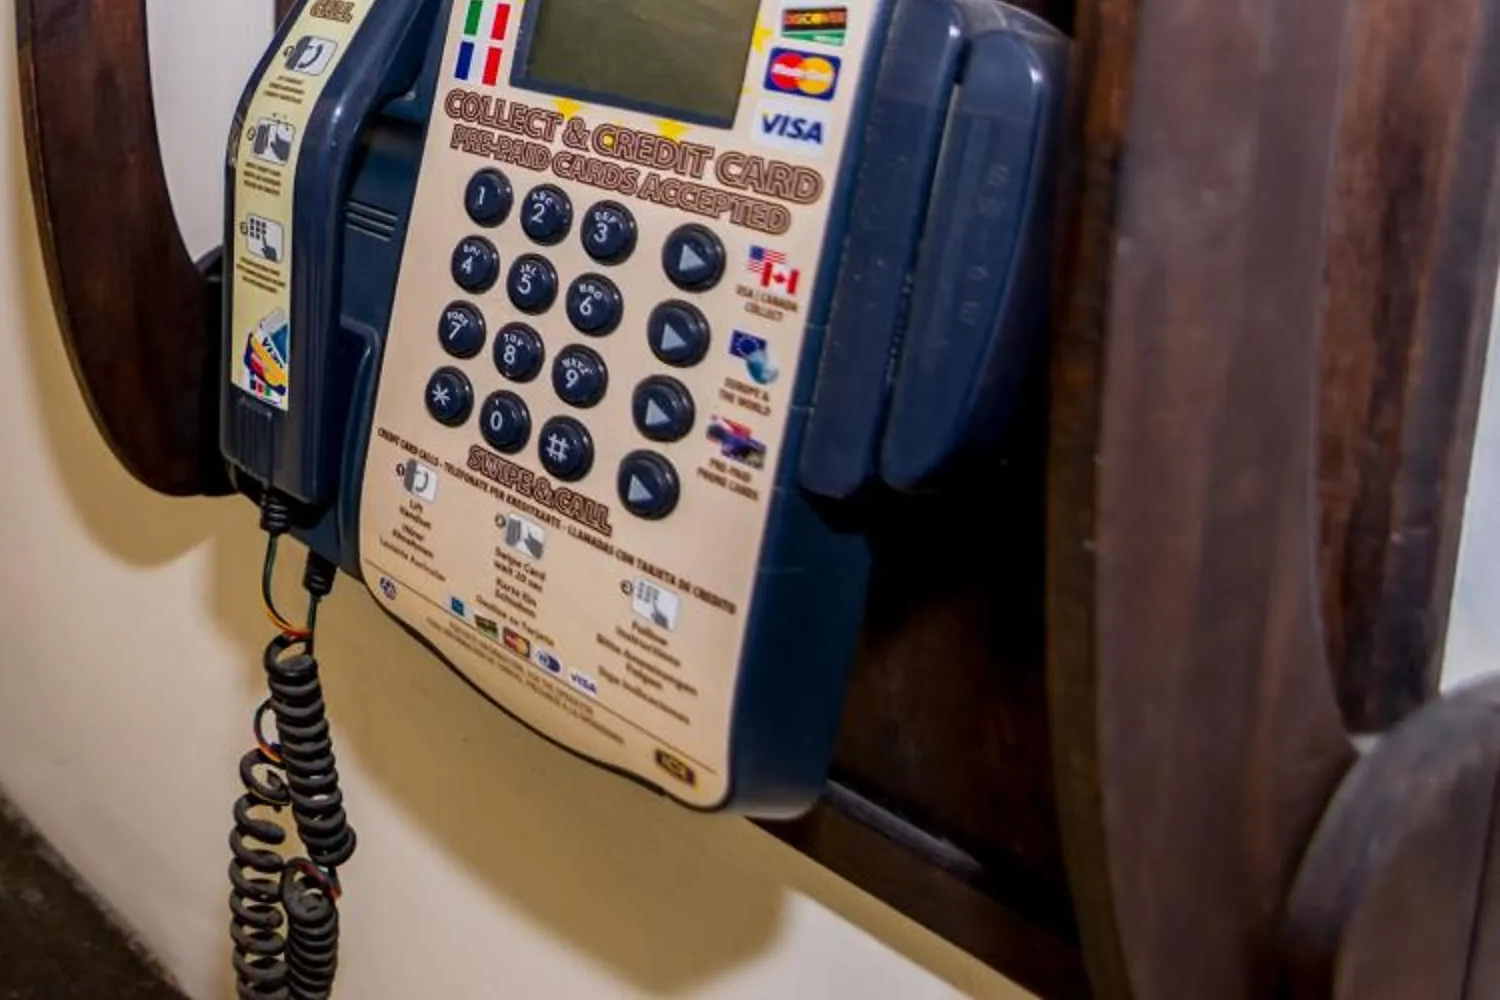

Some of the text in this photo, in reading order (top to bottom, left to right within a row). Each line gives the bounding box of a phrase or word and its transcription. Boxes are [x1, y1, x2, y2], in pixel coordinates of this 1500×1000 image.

[762, 112, 822, 145] VISA
[444, 87, 825, 205] COLLECT & CREDIT CARD
[450, 124, 792, 235] PRE-PAID CARDS ACCEPTED
[531, 203, 545, 223] 2
[593, 222, 607, 243] 3
[461, 255, 473, 275] 4
[517, 275, 531, 295] 5
[579, 296, 592, 316] 6
[449, 321, 461, 340] 7
[503, 344, 515, 364] 8
[565, 369, 579, 389] 9
[490, 411, 503, 431] 0
[467, 444, 612, 536] SWIPE & CALL
